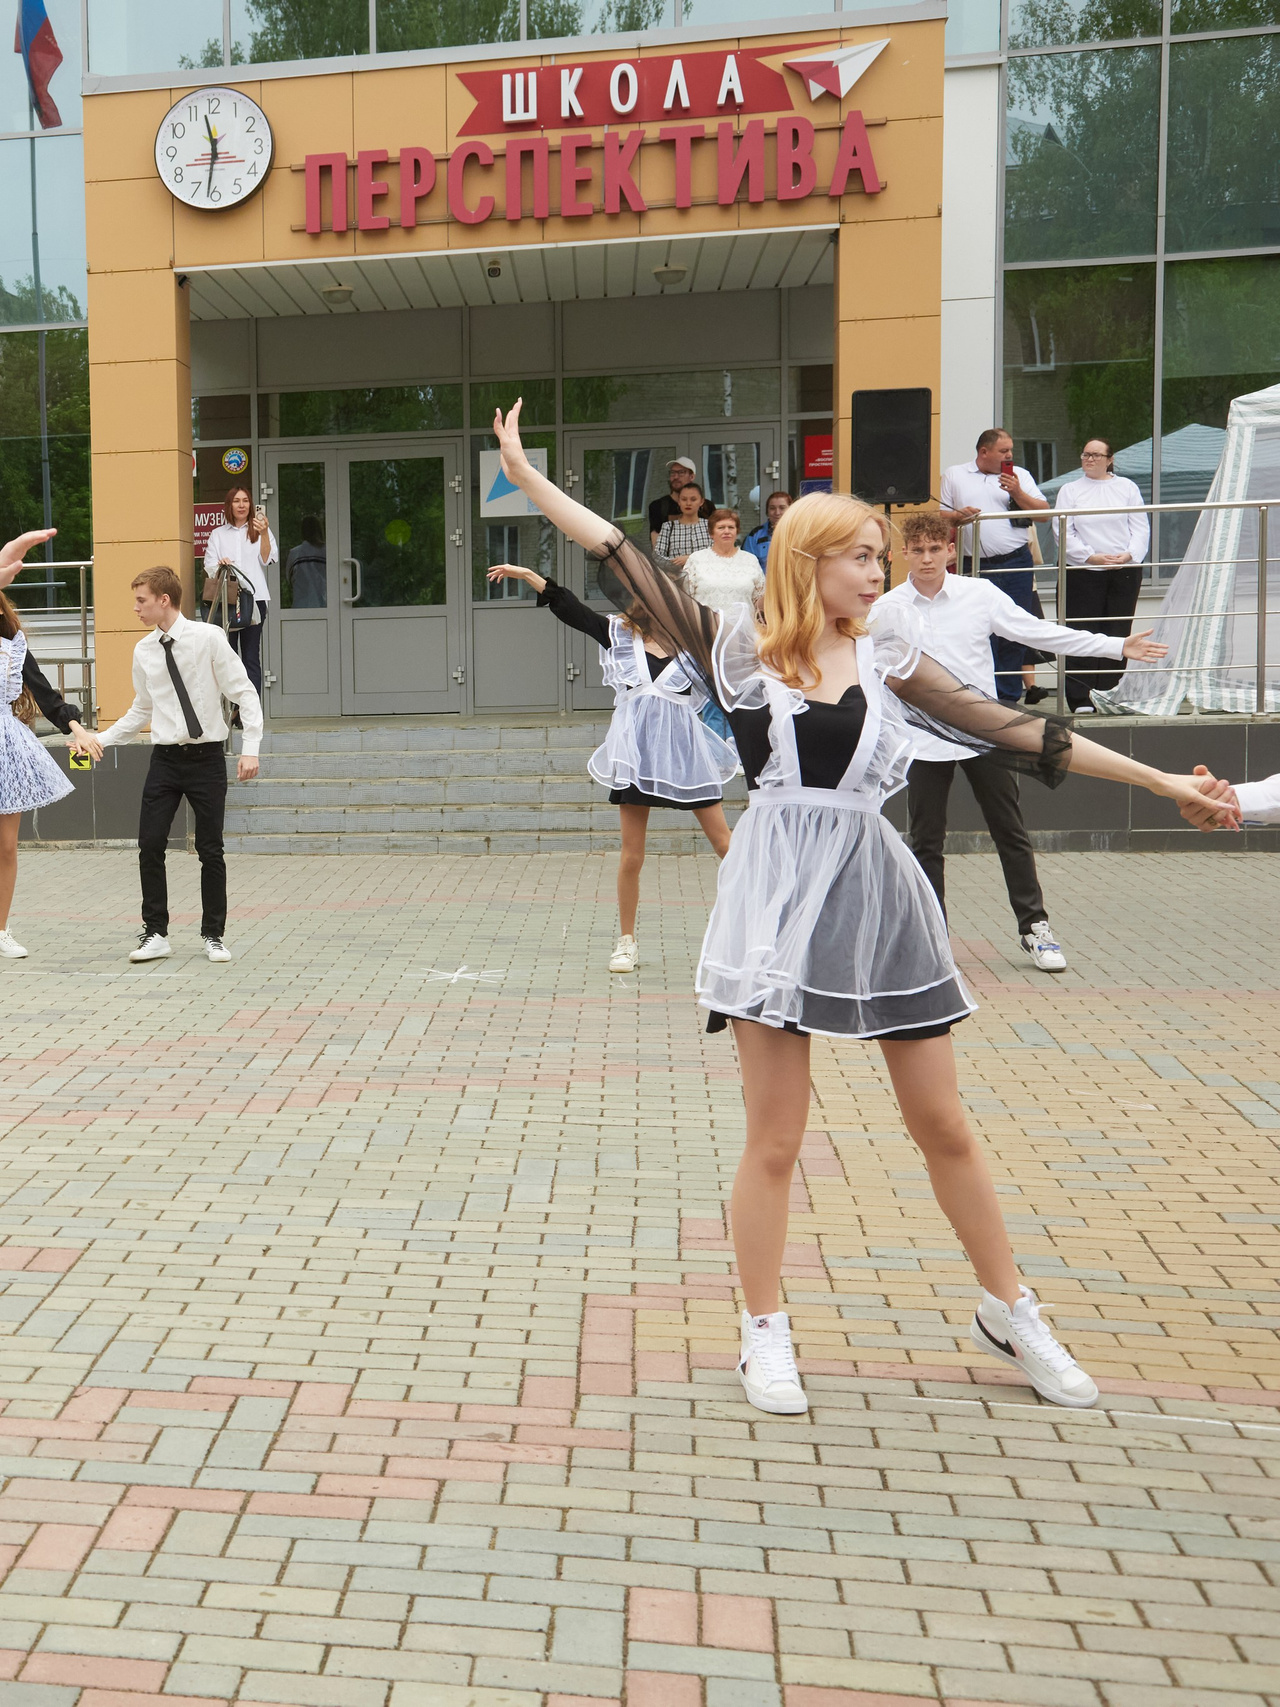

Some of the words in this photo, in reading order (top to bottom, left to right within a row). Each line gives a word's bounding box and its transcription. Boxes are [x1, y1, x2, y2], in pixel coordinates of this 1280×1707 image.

[502, 54, 744, 124] ШКОЛА
[188, 105, 198, 122] 11
[207, 97, 221, 115] 12
[233, 102, 237, 118] 1
[171, 122, 186, 139] 10
[245, 116, 256, 133] 2
[165, 145, 178, 163] 9
[253, 137, 264, 155] 3
[173, 166, 184, 184] 8
[246, 161, 259, 177] 4
[305, 110, 881, 234] ПЕРСПЕКТИВА
[190, 181, 202, 199] 7
[210, 186, 222, 203] 6
[231, 178, 242, 195] 5
[195, 509, 228, 527] МУЗЕЙ
